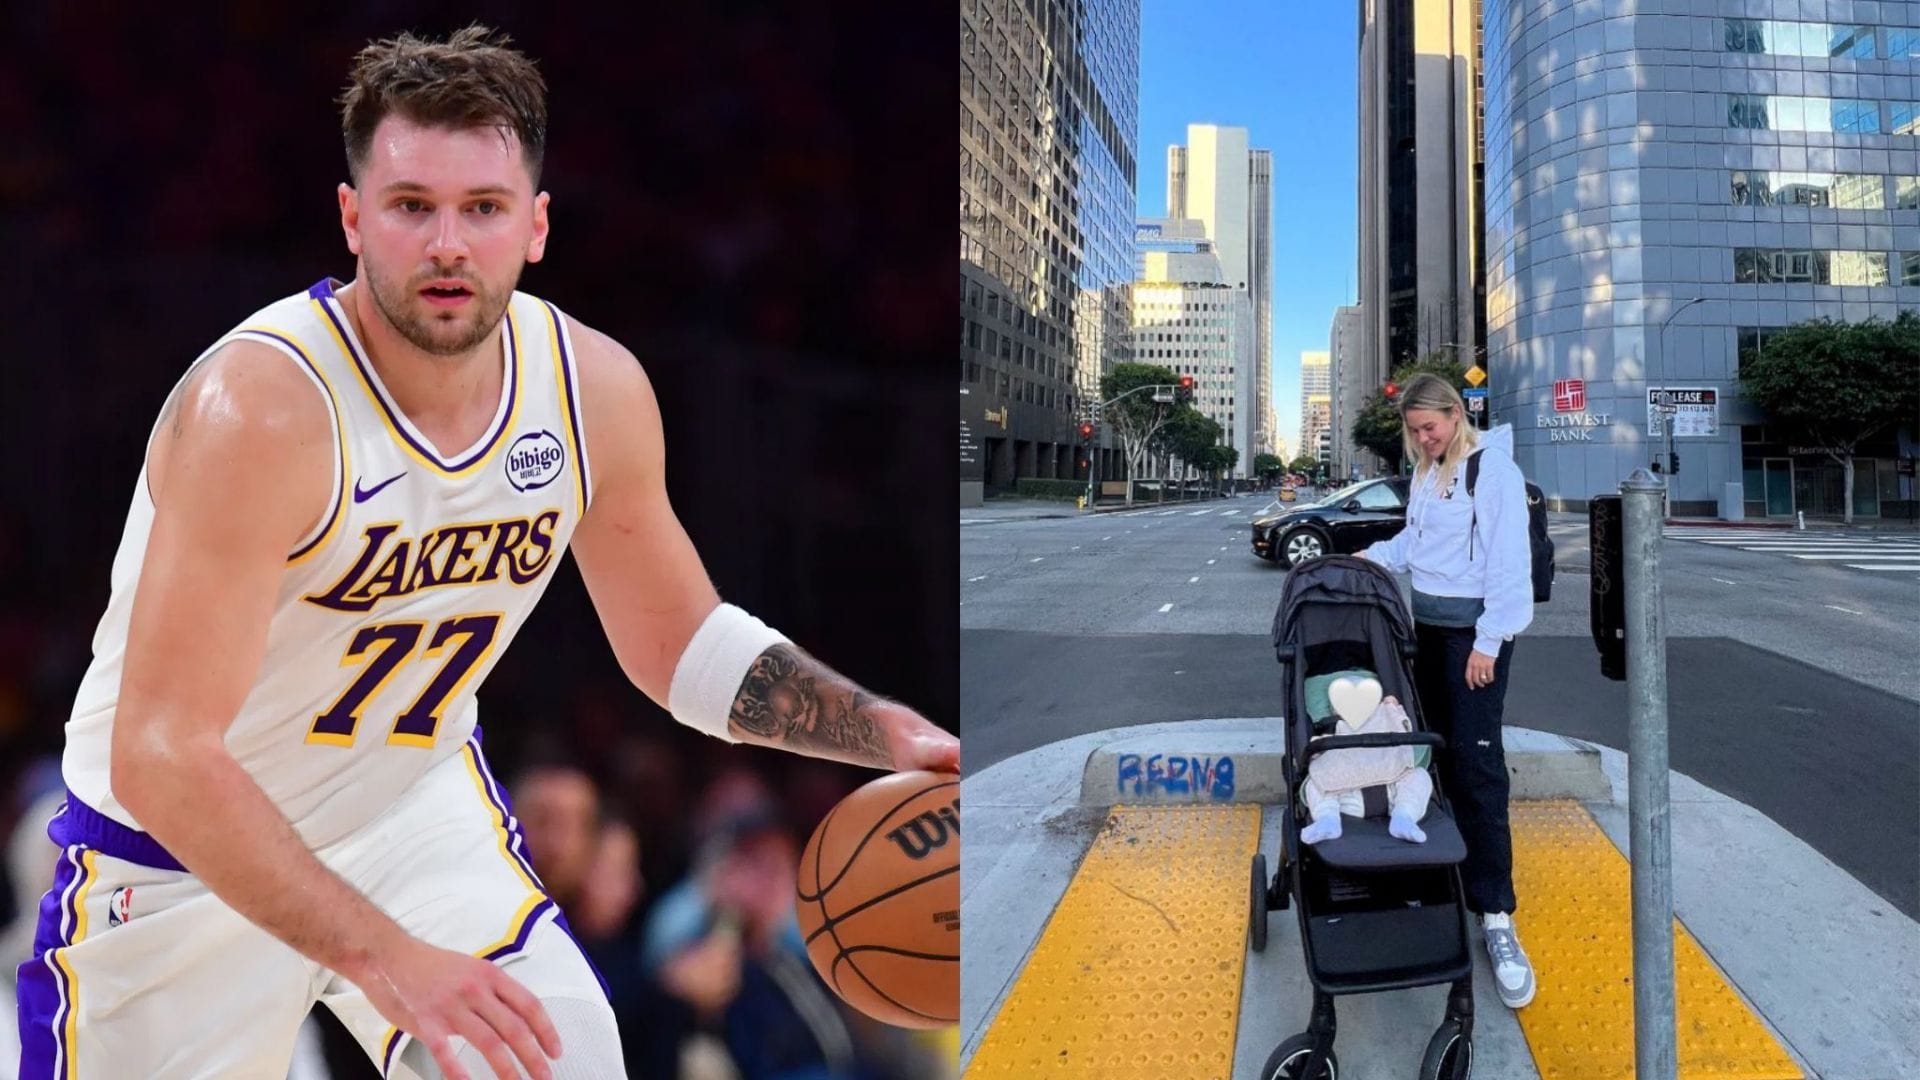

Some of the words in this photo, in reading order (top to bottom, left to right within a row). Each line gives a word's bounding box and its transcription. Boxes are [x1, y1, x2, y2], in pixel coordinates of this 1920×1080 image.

[1673, 392, 1702, 403] LEASE
[1550, 428, 1592, 441] BANK
[510, 446, 560, 472] bibigo
[300, 507, 562, 613] LAKERS
[304, 612, 505, 748] 77
